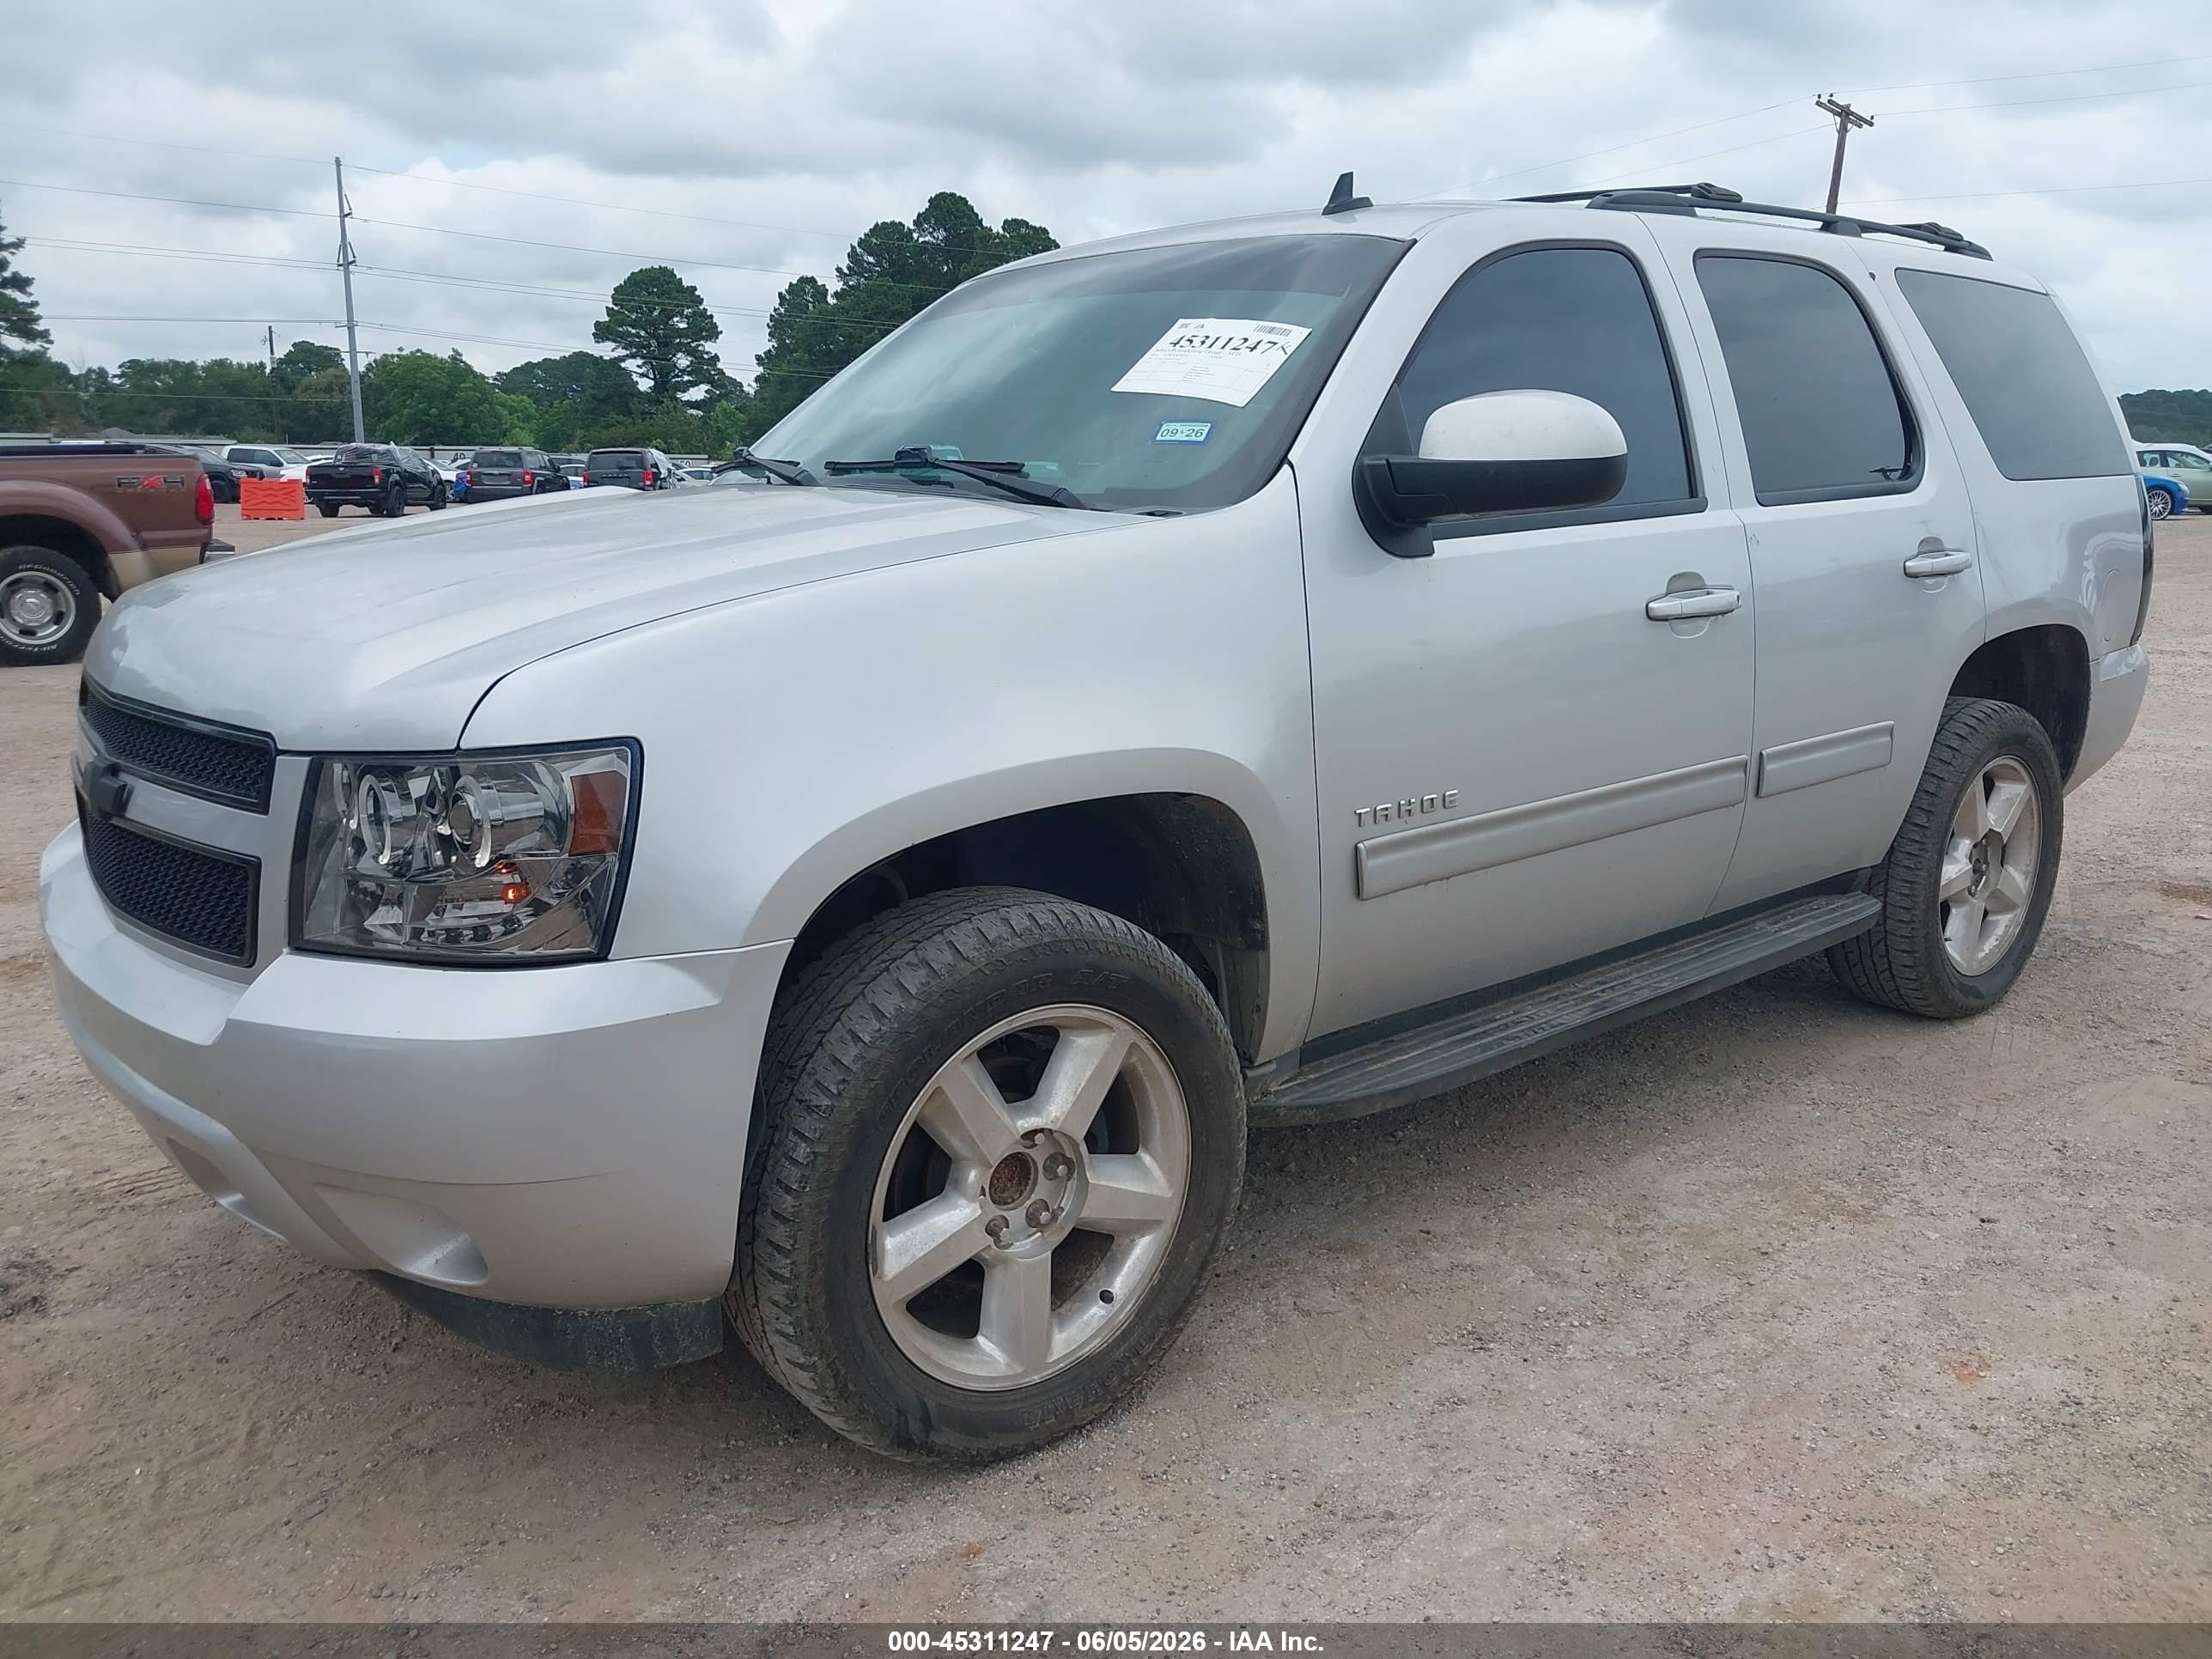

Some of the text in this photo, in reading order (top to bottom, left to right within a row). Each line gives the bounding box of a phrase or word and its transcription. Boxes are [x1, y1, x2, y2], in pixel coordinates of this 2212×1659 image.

[1169, 333, 1279, 355] 45311247
[1184, 428, 1205, 438] 26
[1353, 788, 1459, 828] TAHOE
